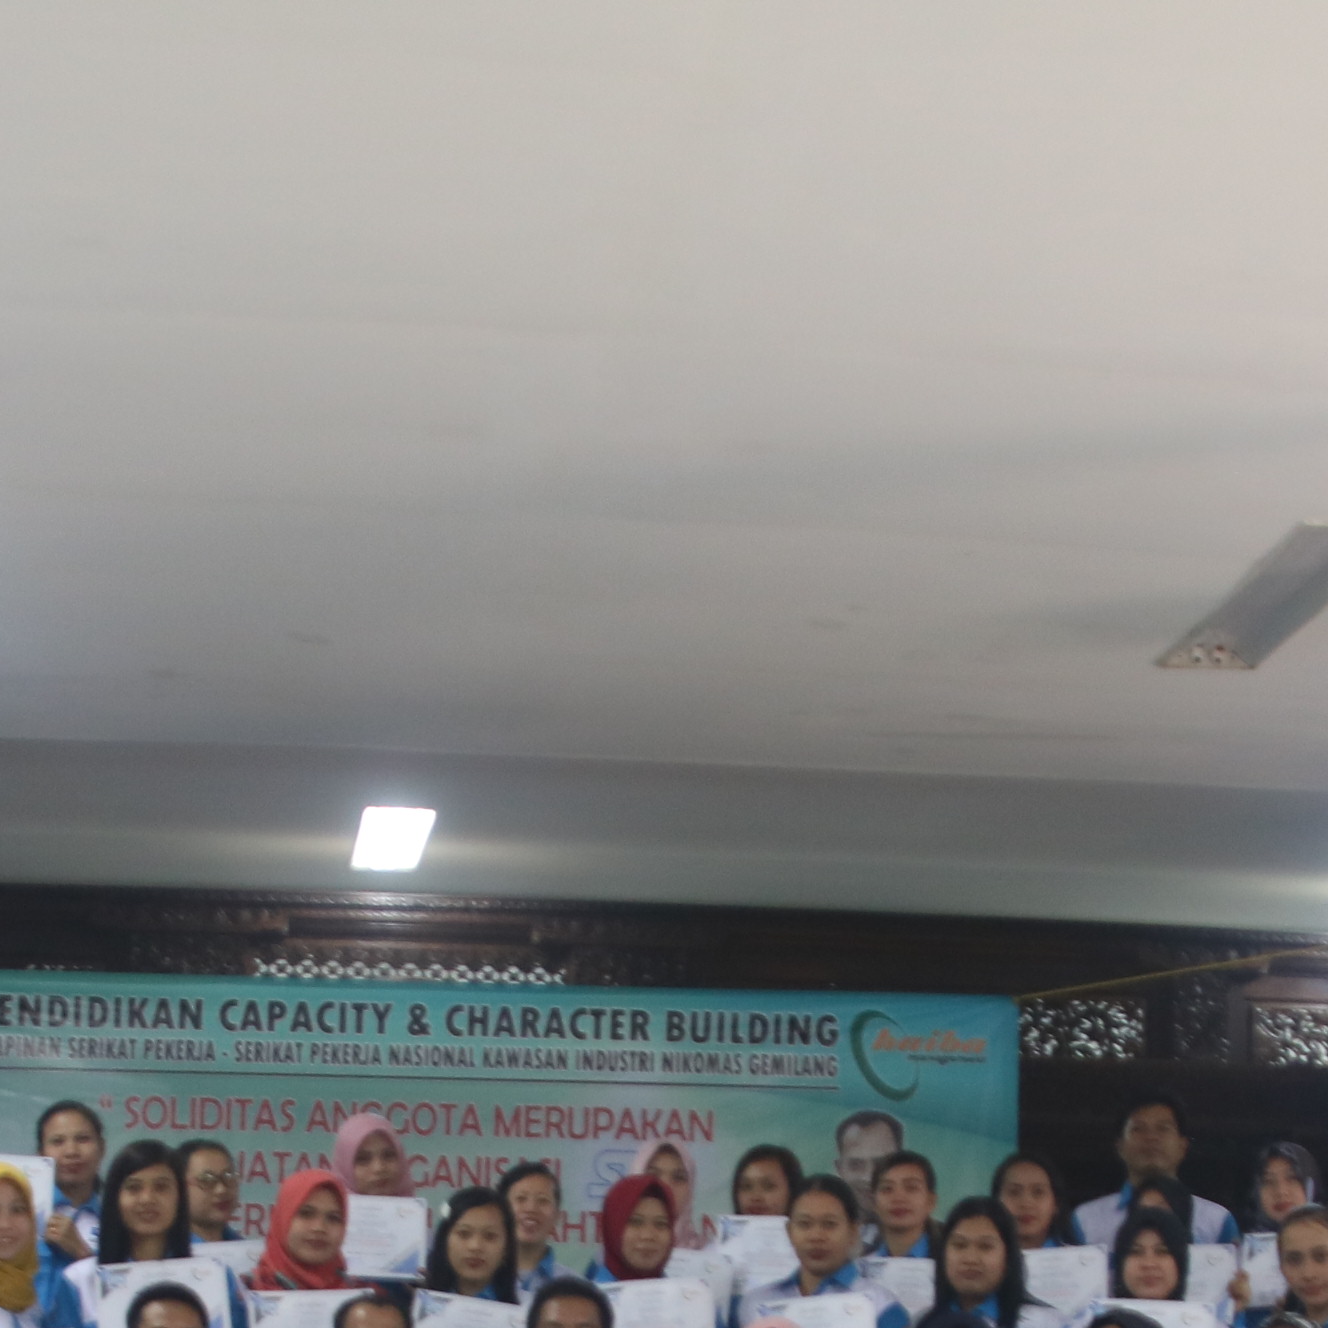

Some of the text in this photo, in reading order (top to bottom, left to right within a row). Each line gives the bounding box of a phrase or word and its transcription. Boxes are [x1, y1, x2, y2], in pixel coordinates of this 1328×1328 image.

[219, 999, 392, 1035] CAPACITY
[407, 1003, 432, 1037] &
[445, 1004, 650, 1041] CHARACTER
[666, 1010, 839, 1047] BUILDING
[68, 1036, 137, 1060] SERIKAT
[144, 1038, 216, 1062] PEKERJA
[234, 1040, 304, 1064] SERIKAT
[310, 1042, 382, 1066] PEKERJA
[389, 1044, 476, 1068] NASIONAL
[483, 1046, 568, 1071] KAWASAN
[576, 1048, 655, 1073] INDUSTRI
[662, 1051, 743, 1075] NIKOMAS
[749, 1054, 839, 1078] GEMILANG
[125, 1095, 295, 1133] SOLIDITAS
[493, 1104, 715, 1142] MERUPAKAN
